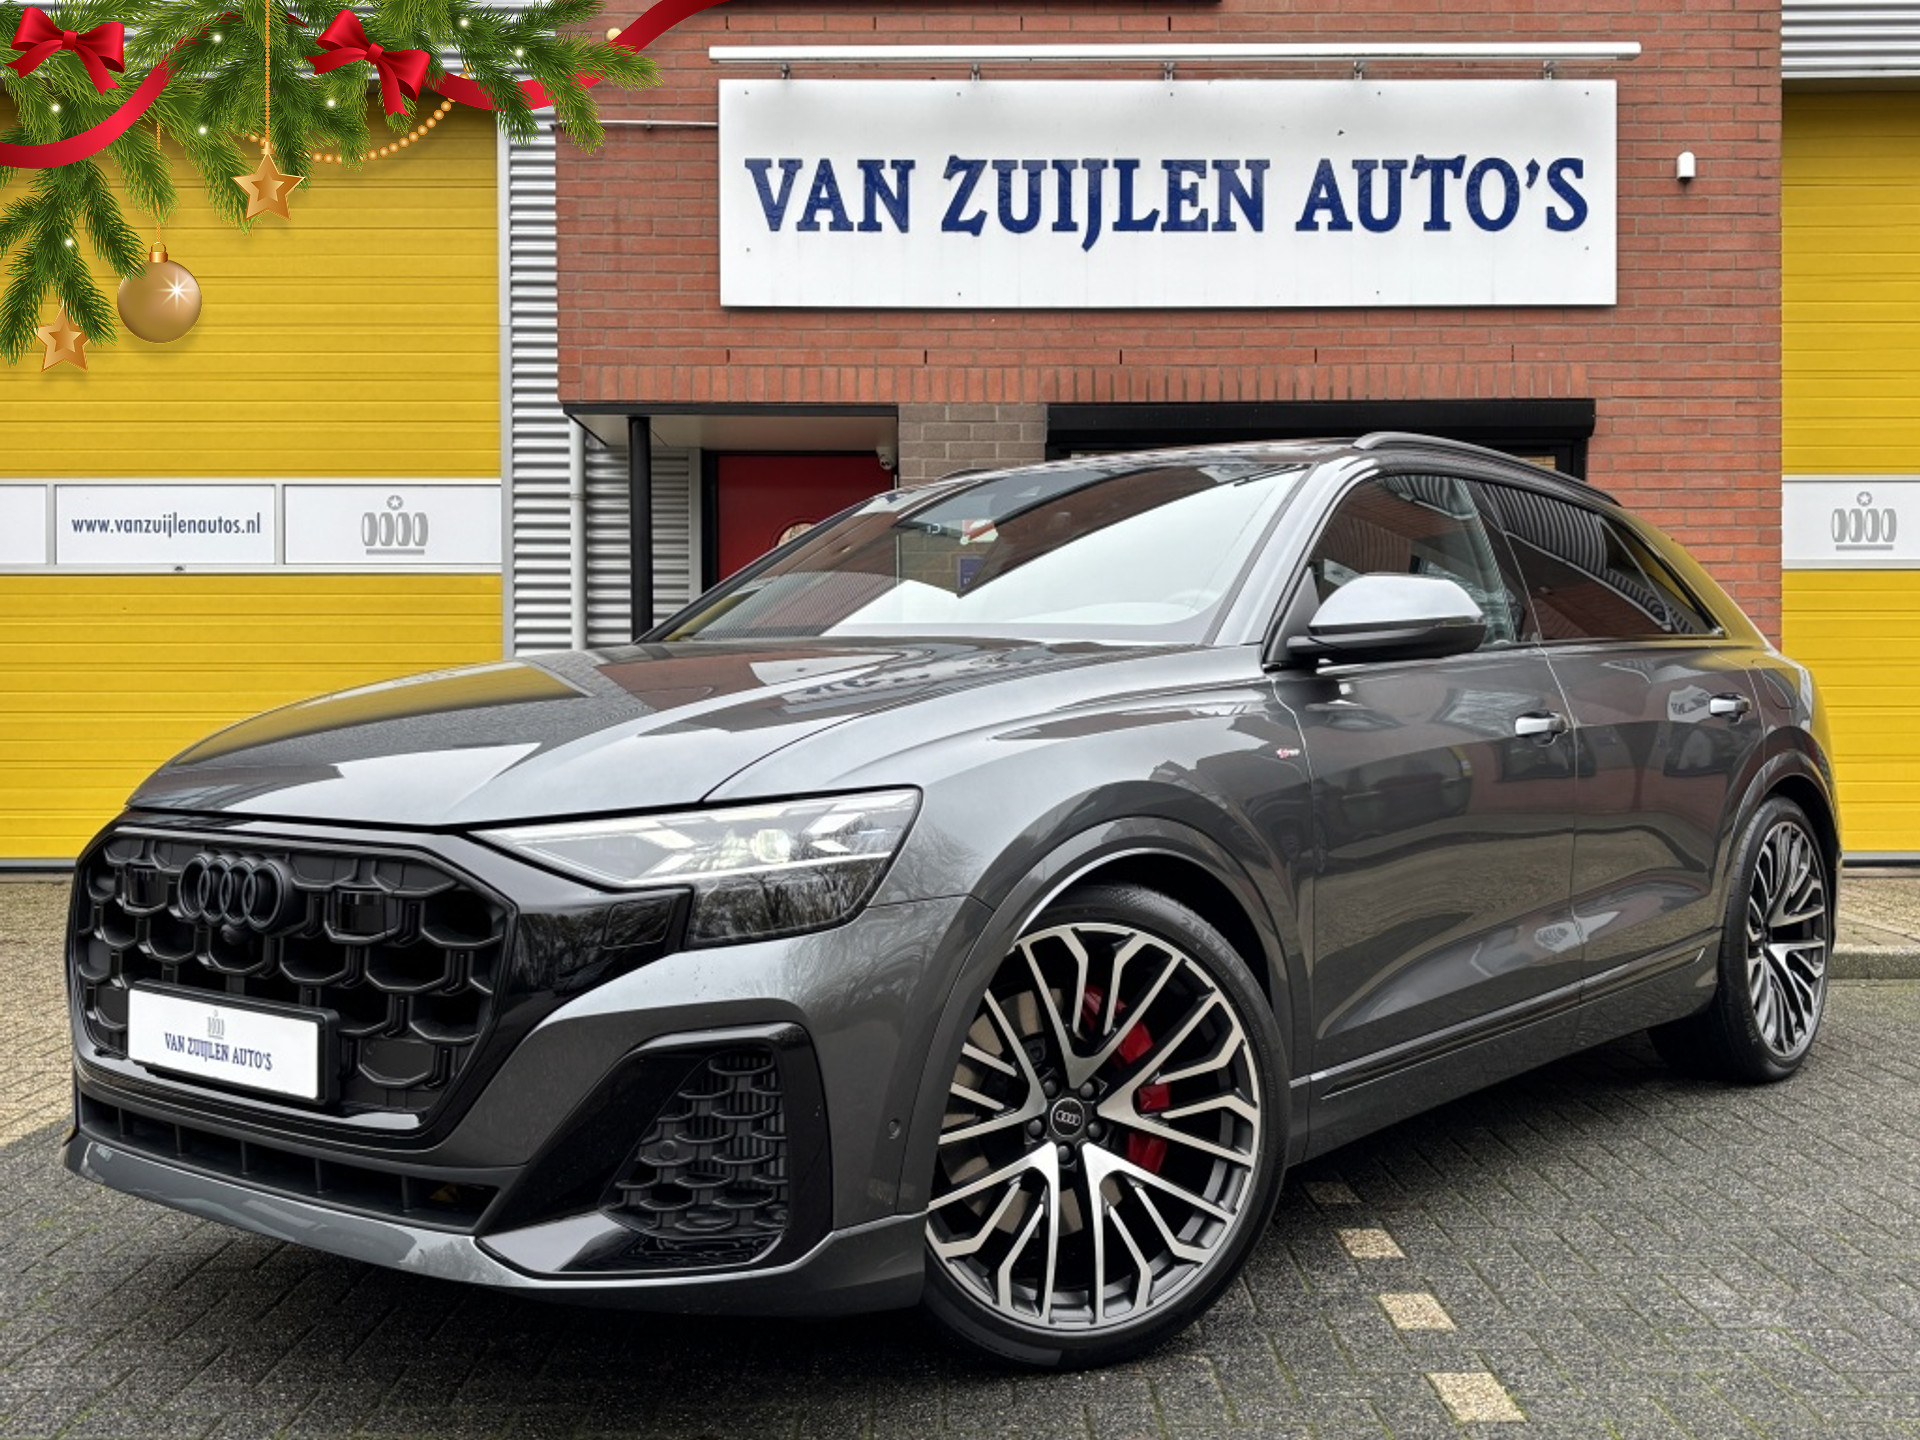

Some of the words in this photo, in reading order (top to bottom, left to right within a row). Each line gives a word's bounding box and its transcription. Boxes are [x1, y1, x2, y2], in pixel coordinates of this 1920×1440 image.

[744, 158, 916, 234] VAN
[941, 155, 1271, 252] ZUIJLEN
[1295, 154, 1589, 233] AUTO'S
[71, 512, 260, 538] www.vanzuijlenautos.nl
[164, 1032, 186, 1053] VAN
[187, 1037, 230, 1063] ZUIJLEN
[232, 1047, 273, 1071] AUTO'S
